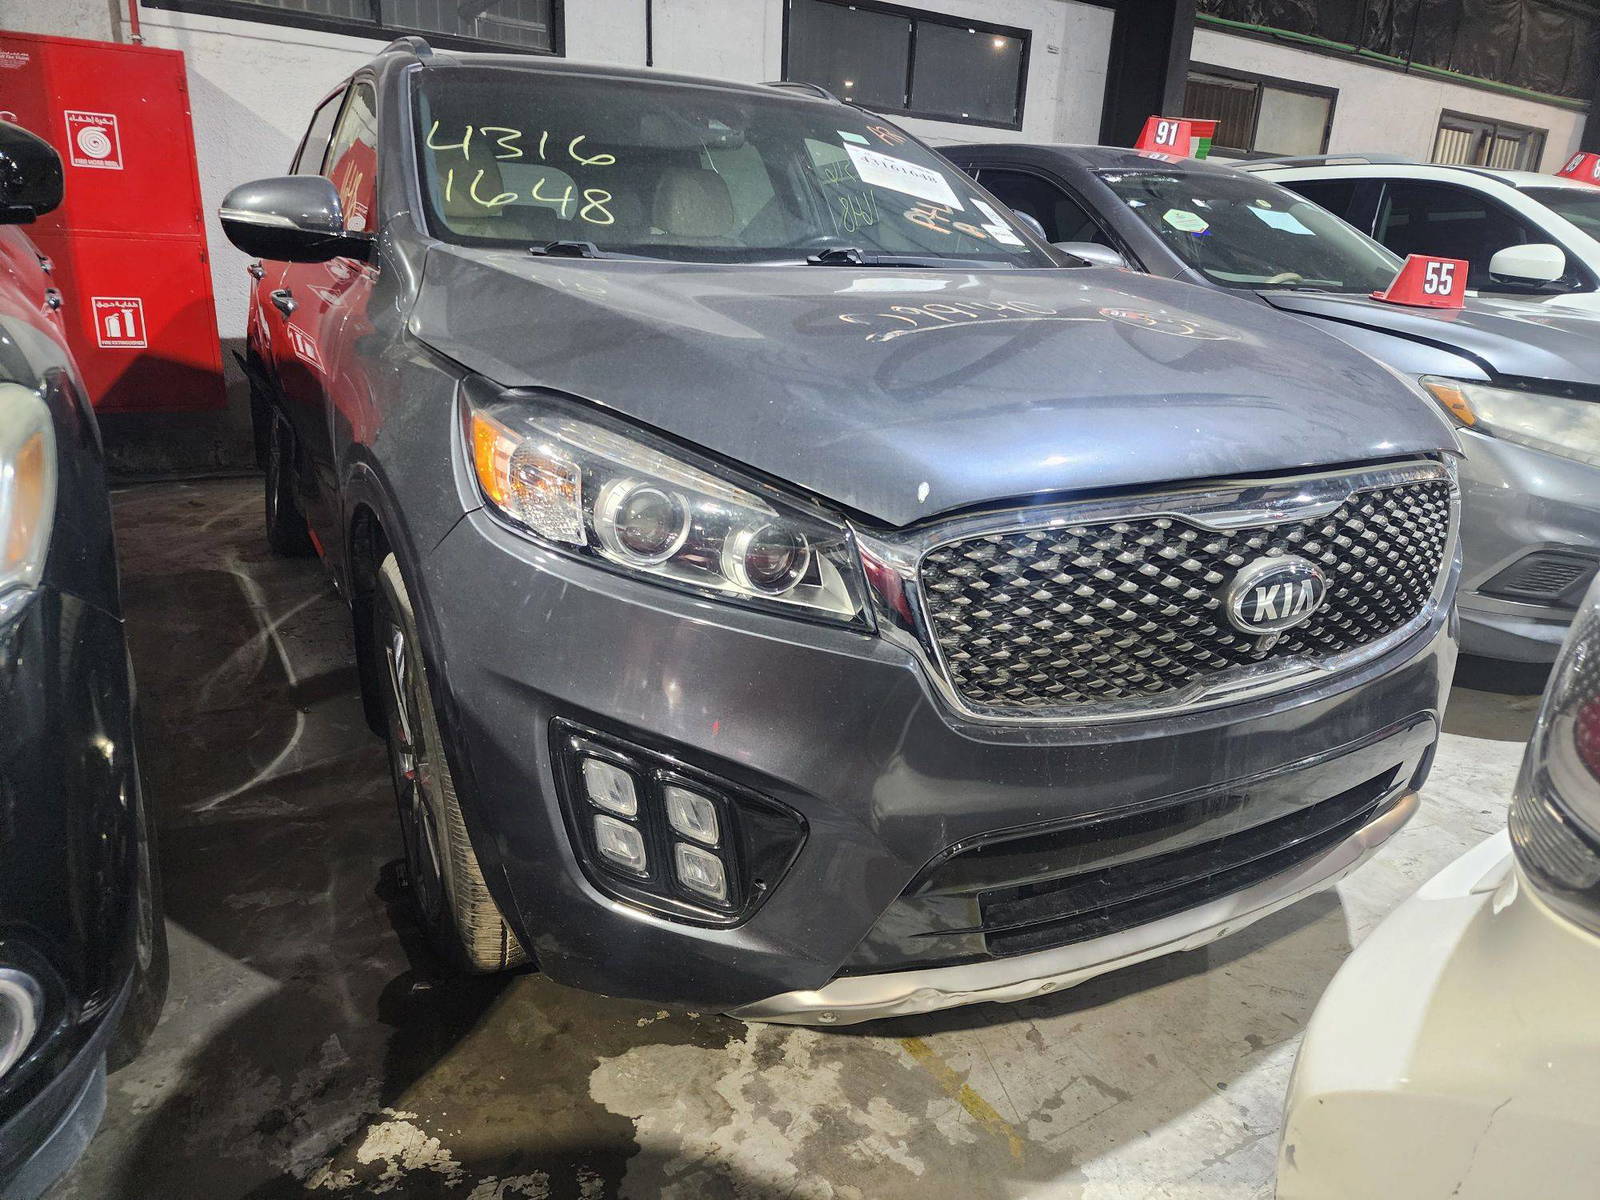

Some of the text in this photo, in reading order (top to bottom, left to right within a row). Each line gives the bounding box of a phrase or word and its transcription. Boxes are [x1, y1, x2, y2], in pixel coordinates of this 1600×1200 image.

[427, 120, 616, 165] 4316
[1155, 121, 1178, 146] 91
[446, 169, 615, 224] 1648
[1424, 261, 1455, 295] 55
[1253, 579, 1314, 622] KIA
